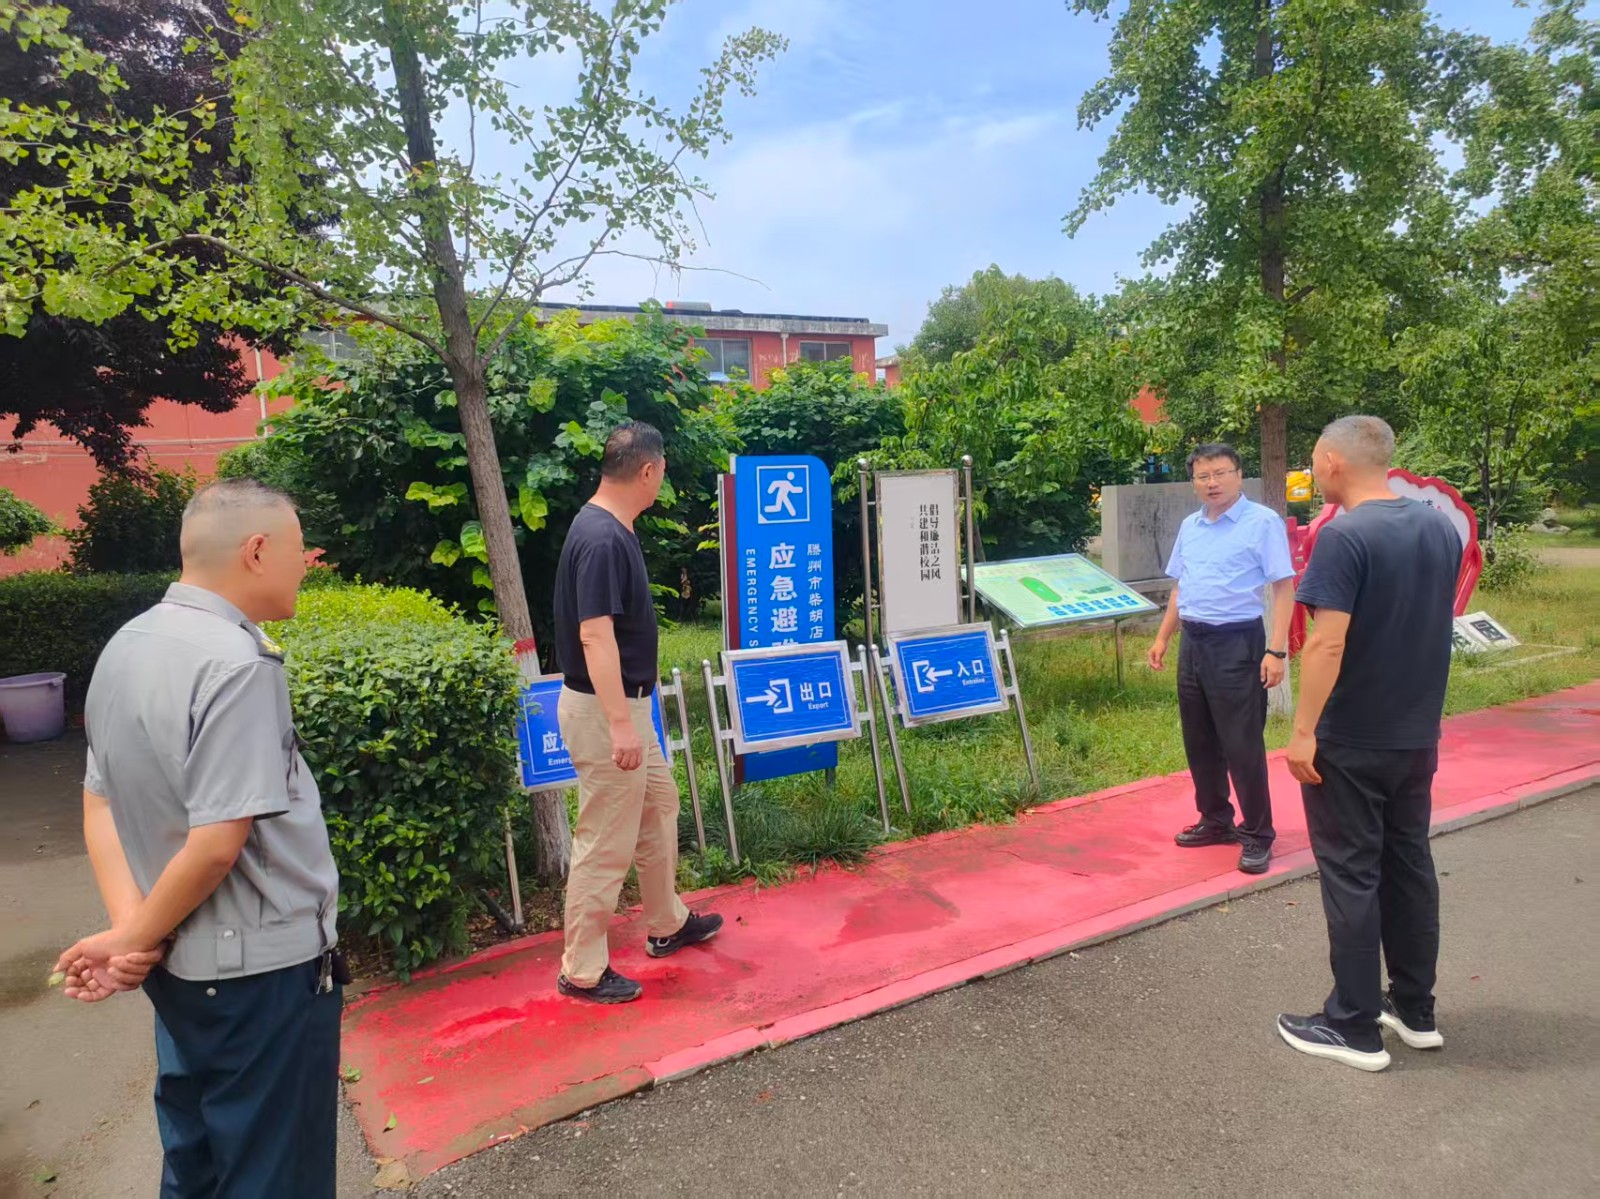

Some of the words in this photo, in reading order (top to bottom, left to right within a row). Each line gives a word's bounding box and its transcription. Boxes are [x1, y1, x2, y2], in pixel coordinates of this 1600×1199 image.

[919, 504, 930, 581] 共建和谐校园
[746, 548, 758, 633] EMERGENCY
[957, 660, 984, 677] 入口
[800, 682, 832, 703] 出口
[808, 701, 829, 710] Export
